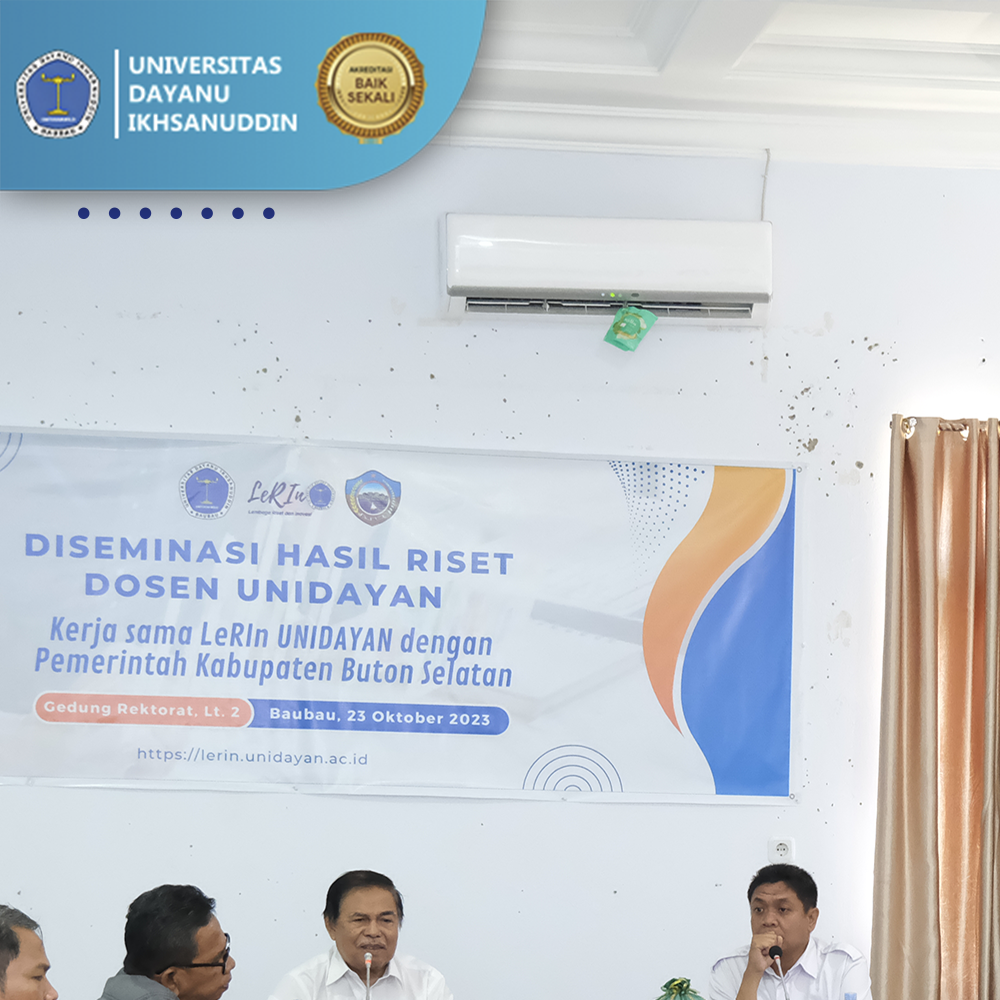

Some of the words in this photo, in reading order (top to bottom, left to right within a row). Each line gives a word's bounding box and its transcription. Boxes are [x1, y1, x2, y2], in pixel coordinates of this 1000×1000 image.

[247, 480, 307, 508] LeRIn
[26, 533, 259, 565] DISEMINASI
[277, 543, 391, 571] HASIL
[407, 548, 514, 575] RISET
[85, 573, 219, 600] DOSEN
[237, 578, 442, 609] UNIDAYAN
[50, 616, 118, 650] Kerja
[125, 623, 193, 645] sama
[200, 621, 269, 648] LeRIn
[277, 624, 393, 652] UNIDAYAN
[400, 627, 493, 661] dengan
[35, 647, 187, 677] Pemerintah
[196, 652, 333, 686] Kabupaten
[341, 657, 414, 684] Buton
[421, 659, 513, 688] Selatan
[43, 701, 111, 716] Gedung
[117, 702, 198, 718] Rektorat,
[204, 705, 225, 718] Lt.
[231, 706, 240, 718] 2
[269, 707, 341, 723] Baubau,
[347, 709, 366, 722] 23
[372, 710, 444, 724] Oktober
[449, 713, 491, 726] 2023
[137, 747, 368, 766] https://lerin.unidayan.ac.id
